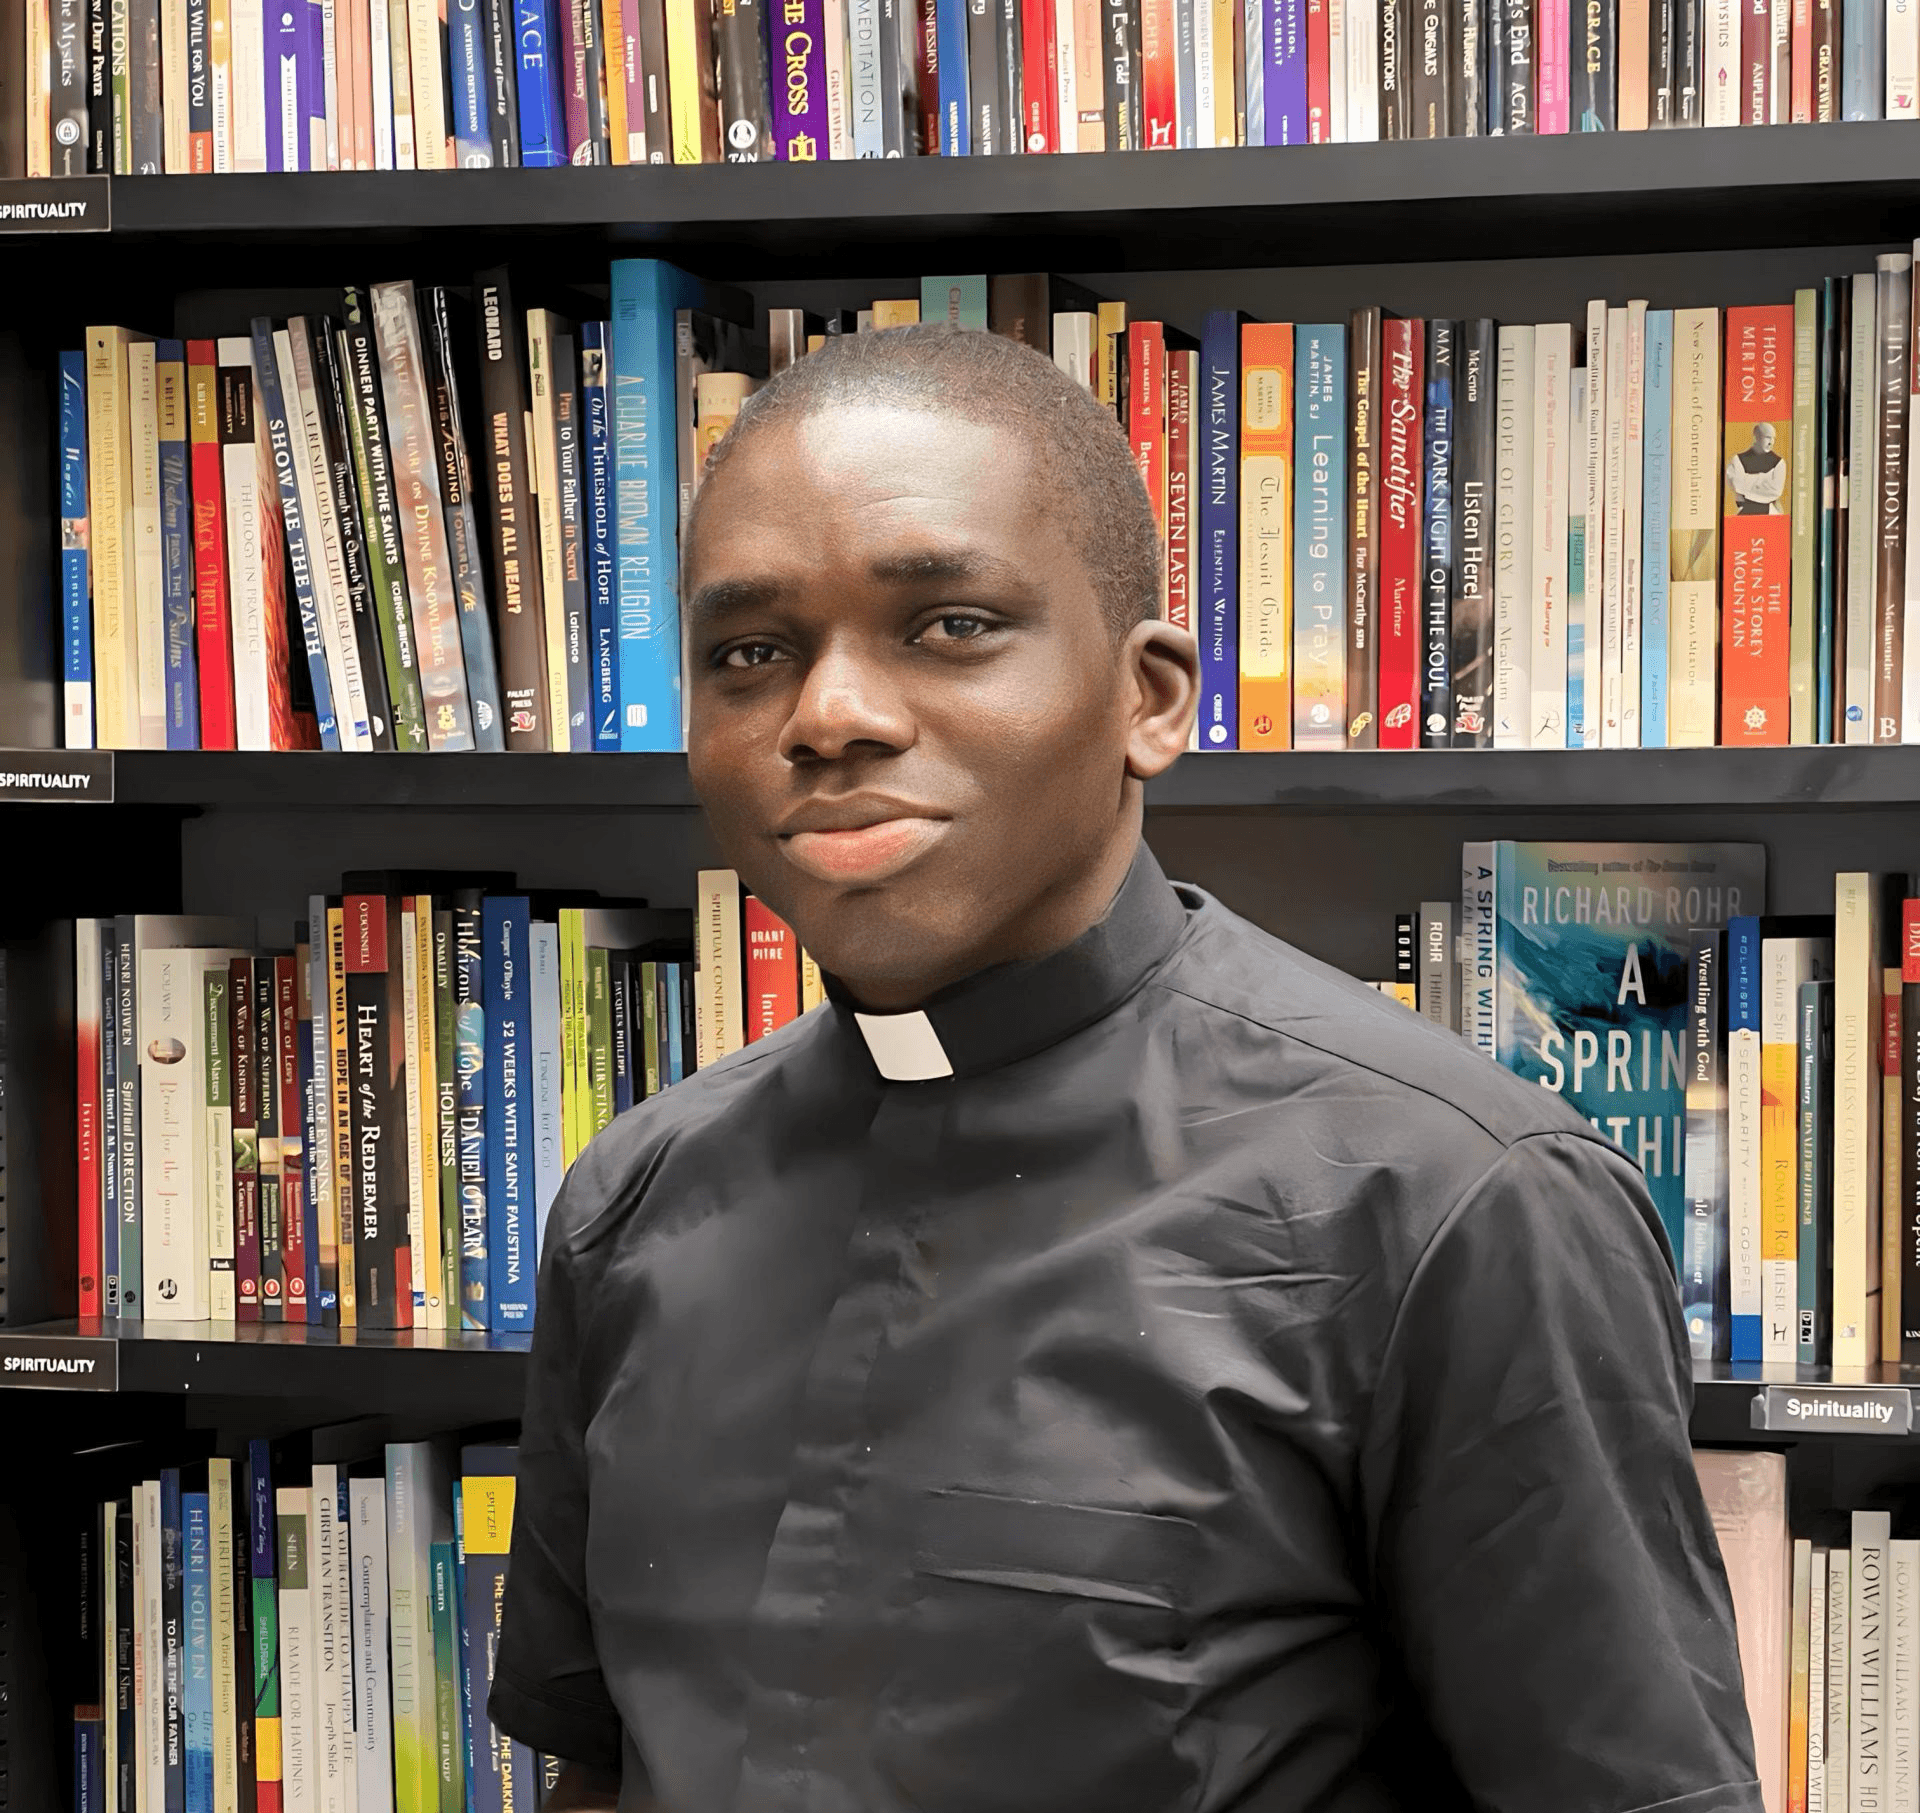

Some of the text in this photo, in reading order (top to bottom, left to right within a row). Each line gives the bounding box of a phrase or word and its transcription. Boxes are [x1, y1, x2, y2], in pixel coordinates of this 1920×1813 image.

[57, 22, 75, 86] Mystics
[784, 32, 812, 116] CROSS
[858, 0, 874, 122] MEDITATION
[1114, 56, 1129, 83] Told
[1588, 1, 1600, 73] GRACE
[1511, 25, 1529, 130] End ACTA
[355, 337, 373, 394] DINNER
[1171, 370, 1179, 420] MARTIN
[1323, 356, 1332, 402] JAMES
[1742, 326, 1755, 402] MERTON
[1763, 325, 1776, 402] THOMAS
[363, 398, 380, 442] PARTY
[1179, 384, 1188, 423] JAMES
[1212, 366, 1229, 504] JAMES MARTIN
[1309, 404, 1319, 419] SJ
[1355, 368, 1369, 494] The Gospel of the
[1692, 396, 1701, 410] of
[371, 444, 388, 481] WITH
[483, 287, 521, 613] LEONARD WHAT DOES IT ALL MEAN?
[1384, 400, 1416, 528] Sanctifier
[1463, 350, 1482, 600] McKenna Listen Here!
[1500, 468, 1514, 491] OF
[1688, 414, 1702, 516] Contemplation
[1885, 378, 1902, 547] WILL BE DONE
[378, 484, 391, 511] THE
[562, 444, 577, 537] Your Father in
[616, 375, 650, 639] A CHARLIE BROWN RELIGION
[1429, 329, 1450, 691] MAY THE DARK NIGHT OF THE SOUL
[269, 419, 321, 657] SHOW ME THE PATH
[382, 515, 397, 564] SAINTS
[591, 397, 611, 703] On THRESHOLD of HOPE LANGBERG
[1170, 472, 1185, 599] SEVEN LAST
[1309, 435, 1333, 665] Learning to Pray
[1500, 504, 1513, 573] GLORY
[1733, 552, 1746, 647] MOUNTAIN
[1751, 538, 1764, 658] SEVEN STOREY
[1768, 583, 1781, 613] THE
[335, 595, 361, 698] OUR FATHER
[712, 894, 721, 962] SPIRITUAL
[1430, 922, 1442, 962] ROHR
[1478, 865, 1492, 977] A SPRING
[1522, 886, 1742, 924] RICHARD ROHR
[1618, 943, 1646, 1005] A
[313, 1013, 324, 1044] THE
[1695, 948, 1711, 1081] Wrestling with God
[121, 944, 135, 1222] HENRI NOUWEN Spiritual DIRECTION
[314, 1051, 326, 1098] LIGHT
[337, 1048, 347, 1086] HOPE
[338, 1091, 348, 1104] IN
[1540, 1030, 1686, 1093] SPRIN
[317, 1103, 328, 1126] OF
[339, 1109, 349, 1128] AN
[340, 1134, 350, 1159] AGE
[358, 1005, 379, 1240] HEART of the REDEEMER
[441, 1083, 454, 1166] HOLINESS
[1739, 1049, 1748, 1168] SECULARITY
[503, 1020, 519, 1283] 52 WEEKS WITH SAINT FAUSTINA
[4, 1357, 95, 1373] SPIRITUALITY
[1787, 1399, 1893, 1423] Spirituality
[319, 1498, 331, 1577] CHRISTIAN
[190, 1510, 206, 1679] HENRI NOUWEN
[323, 1584, 335, 1672] TRANSITION
[364, 1650, 375, 1674] and
[1830, 1570, 1844, 1724] ROWAN WILLIAMS
[1860, 1548, 1880, 1774] ROWAN WILLIAMS
[1896, 1561, 1910, 1721] ROWAN WILLIAMS
[168, 1619, 178, 1765] TO DARE THE OUR FATHER
[365, 1677, 376, 1753] Community
[1809, 1733, 1822, 1770] GOD
